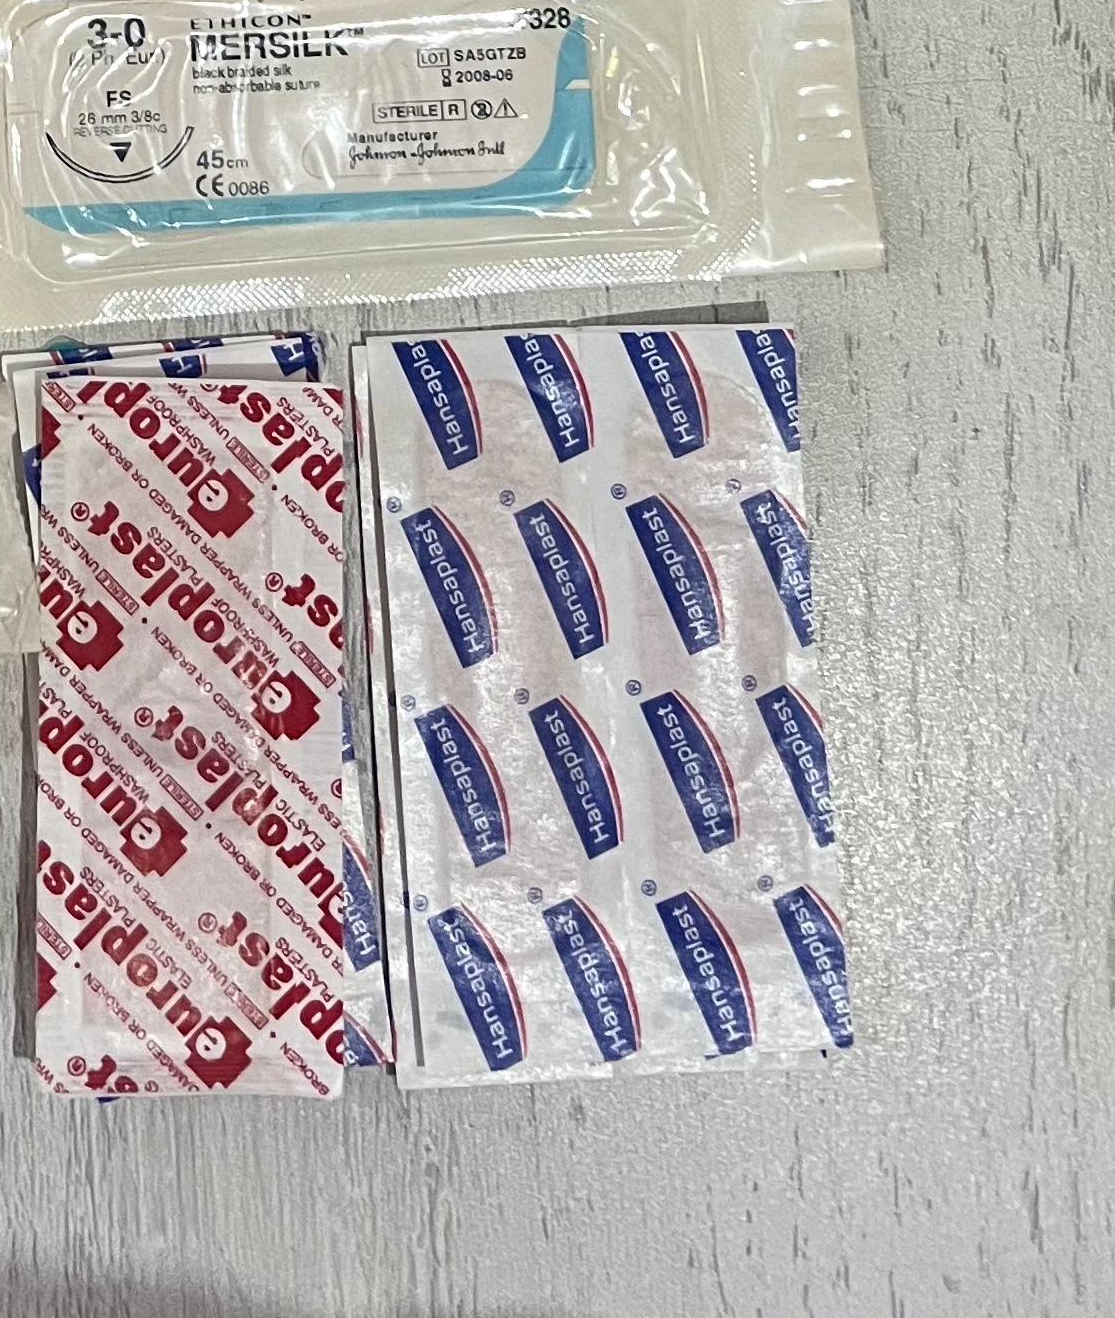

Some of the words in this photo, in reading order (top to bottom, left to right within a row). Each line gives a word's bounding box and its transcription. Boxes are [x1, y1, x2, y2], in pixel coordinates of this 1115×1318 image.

[87, 18, 146, 49] 3-0
[190, 28, 349, 63] MERSILK
[421, 51, 447, 65] LOT
[455, 69, 513, 83] 2008-06
[79, 112, 98, 125] 26
[101, 114, 126, 124] mm
[377, 104, 439, 118] STERILE
[449, 104, 459, 115] R
[347, 131, 438, 144] Manufacturer
[228, 181, 270, 196] 0086
[148, 488, 203, 545] DAMAGED
[147, 526, 204, 587] PLASTERS
[200, 545, 253, 600] WRAPPER
[530, 513, 595, 645] Hansaplast
[642, 507, 712, 641] Hansaplast
[415, 519, 484, 654] Hansaplast
[544, 709, 609, 844] Hansaplast
[673, 905, 744, 1044] Hansaplast
